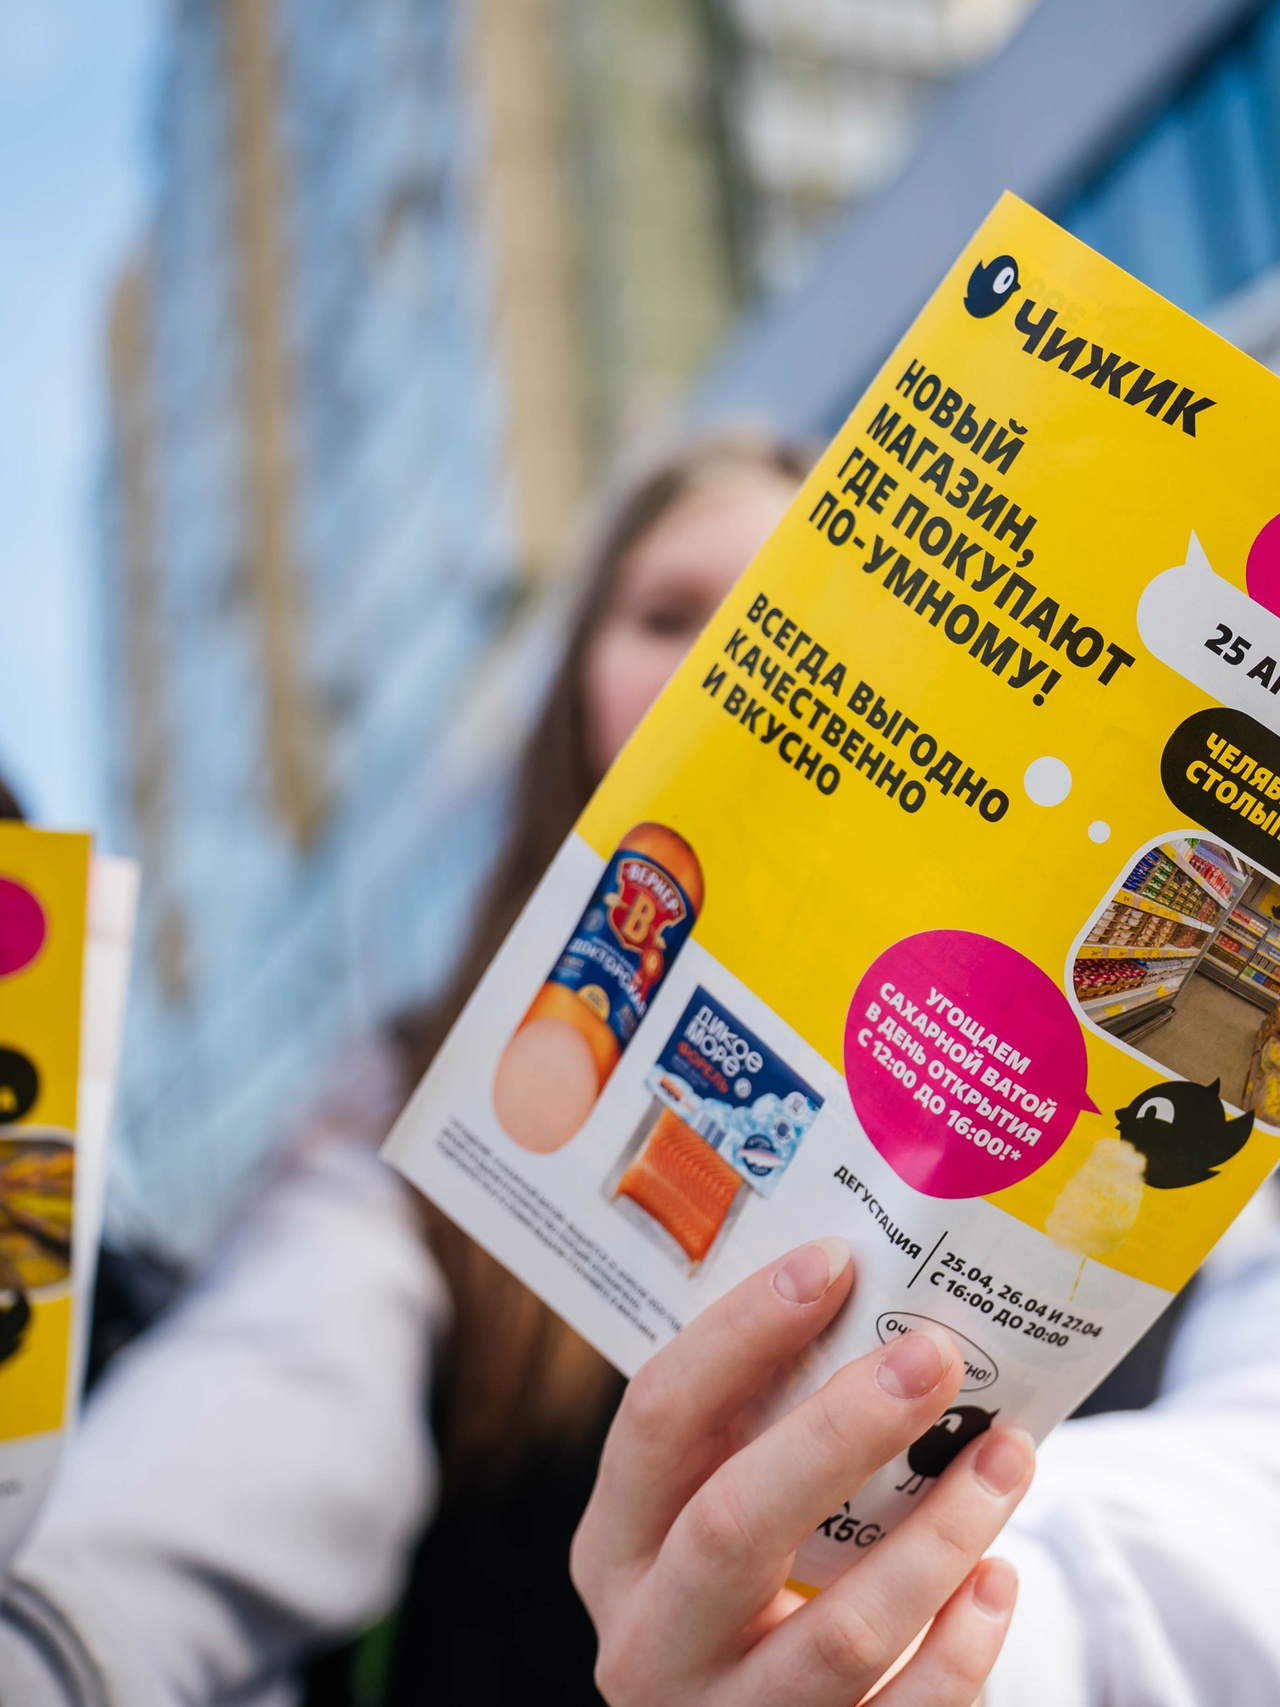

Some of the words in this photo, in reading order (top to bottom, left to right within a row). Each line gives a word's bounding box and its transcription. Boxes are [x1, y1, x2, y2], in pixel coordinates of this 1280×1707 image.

[895, 358, 1029, 476] НОВЫЙ
[866, 402, 1038, 568] МАГАЗИН,
[808, 490, 1063, 707] ПО-УМНОМУ!
[837, 446, 899, 515] ГДЕ
[891, 493, 1136, 686] ПОКУПАЮТ
[746, 593, 847, 697] ВСЕГДА
[846, 680, 1010, 823] ВЫГОДНО
[1204, 623, 1252, 666] 25
[702, 663, 727, 697] И
[722, 683, 841, 796] ВКУСНО
[724, 628, 927, 814] КАЧЕСТВЕННО
[858, 1028, 873, 1047] С
[872, 1040, 917, 1089] 12:00
[913, 1083, 946, 1115] ДО
[865, 1001, 882, 1022] В
[877, 1016, 927, 1065] ДЕНЬ
[928, 1059, 1042, 1147] ОТКРЫТИЯ
[880, 982, 984, 1075] САХАРНОЙ
[980, 1066, 1058, 1123] ВАТОЙ
[925, 986, 1032, 1075] УГОЩАЕМ
[833, 1165, 923, 1260] ДЕГУСТАЦИЯ
[929, 1271, 945, 1286] С
[946, 1279, 995, 1314] 16:00
[991, 1308, 1024, 1330] ДО
[1022, 1321, 1069, 1347] 20:00
[940, 1251, 994, 1295] 25.04,
[997, 1284, 1048, 1318] 26.04
[1047, 1309, 1064, 1324] И
[1061, 1315, 1103, 1338] 27.04
